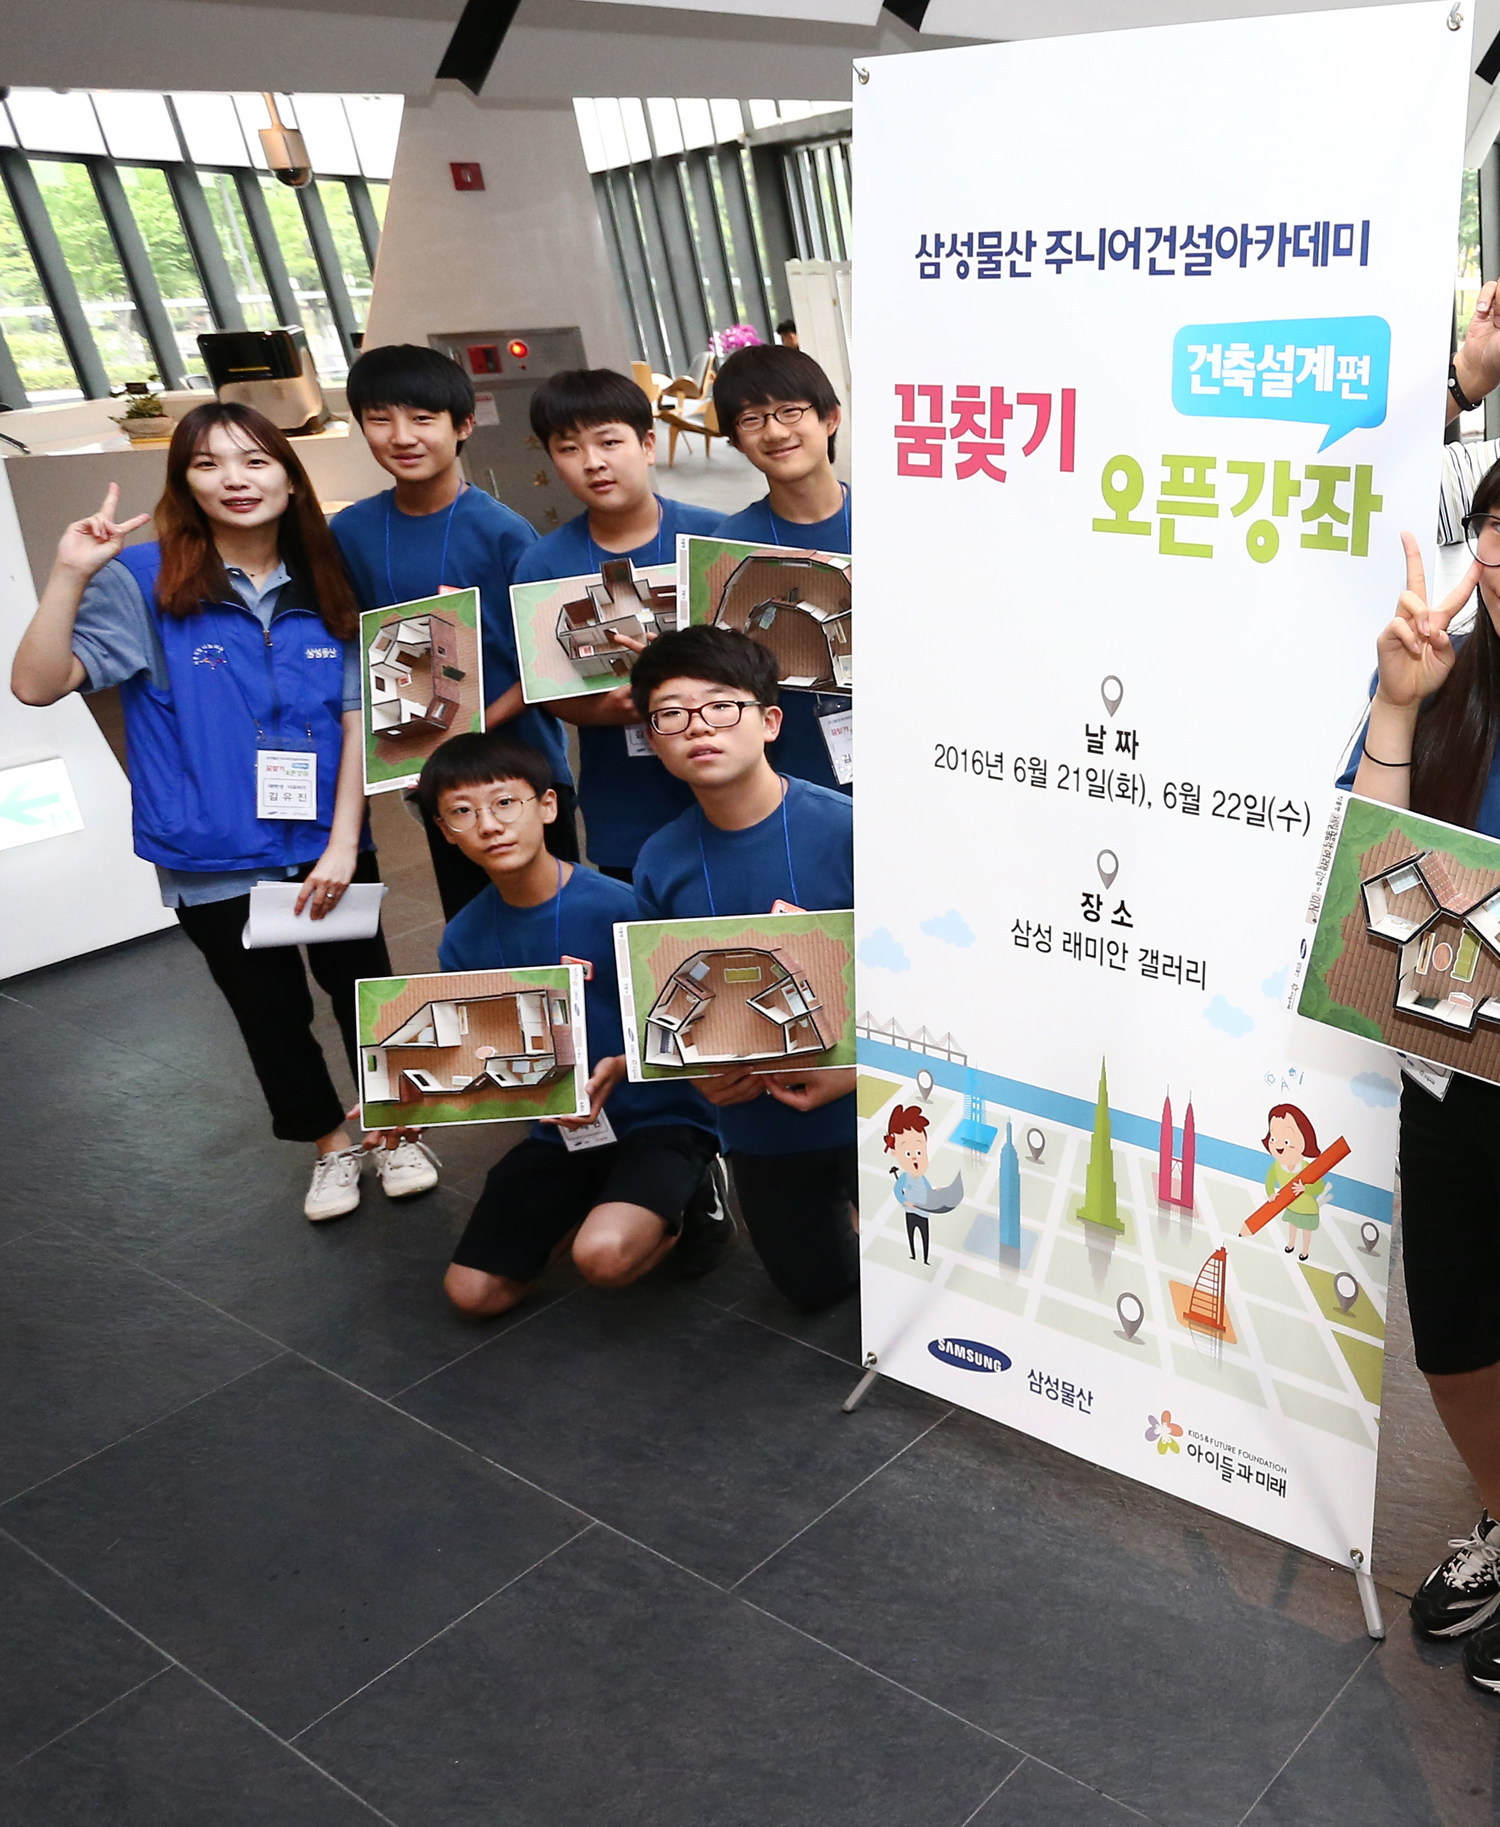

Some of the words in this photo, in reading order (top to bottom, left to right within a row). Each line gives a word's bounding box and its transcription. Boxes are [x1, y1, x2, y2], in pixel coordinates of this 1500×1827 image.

[915, 229, 1037, 280] 삼성물산
[1045, 219, 1371, 277] 주니어건설아카데미
[1186, 341, 1371, 401] 건축설계편
[893, 383, 1077, 484] 꿈찾기
[1091, 453, 1384, 565] 오픈강좌
[1084, 723, 1107, 755] 날
[1115, 729, 1140, 760] 짜
[269, 792, 278, 801] 김
[282, 792, 293, 802] 유
[298, 793, 307, 803] 진
[934, 743, 1005, 781] 2016년
[1013, 756, 1048, 789] 6월
[1057, 763, 1153, 809] 21일(화),
[1162, 781, 1201, 816] 6월
[1211, 789, 1312, 837] 22일(수)
[1080, 891, 1103, 923] 장
[1110, 899, 1134, 928] 소
[1010, 918, 1053, 954] 삼성
[1062, 931, 1129, 972] 래미안
[1138, 948, 1207, 991] 갤러리
[937, 1338, 1002, 1372] SAMSUNG
[1027, 1368, 1094, 1415] 삼성물산
[1188, 1429, 1236, 1454] KIDS&FUTURE
[1238, 1448, 1288, 1474] FOUNDATION
